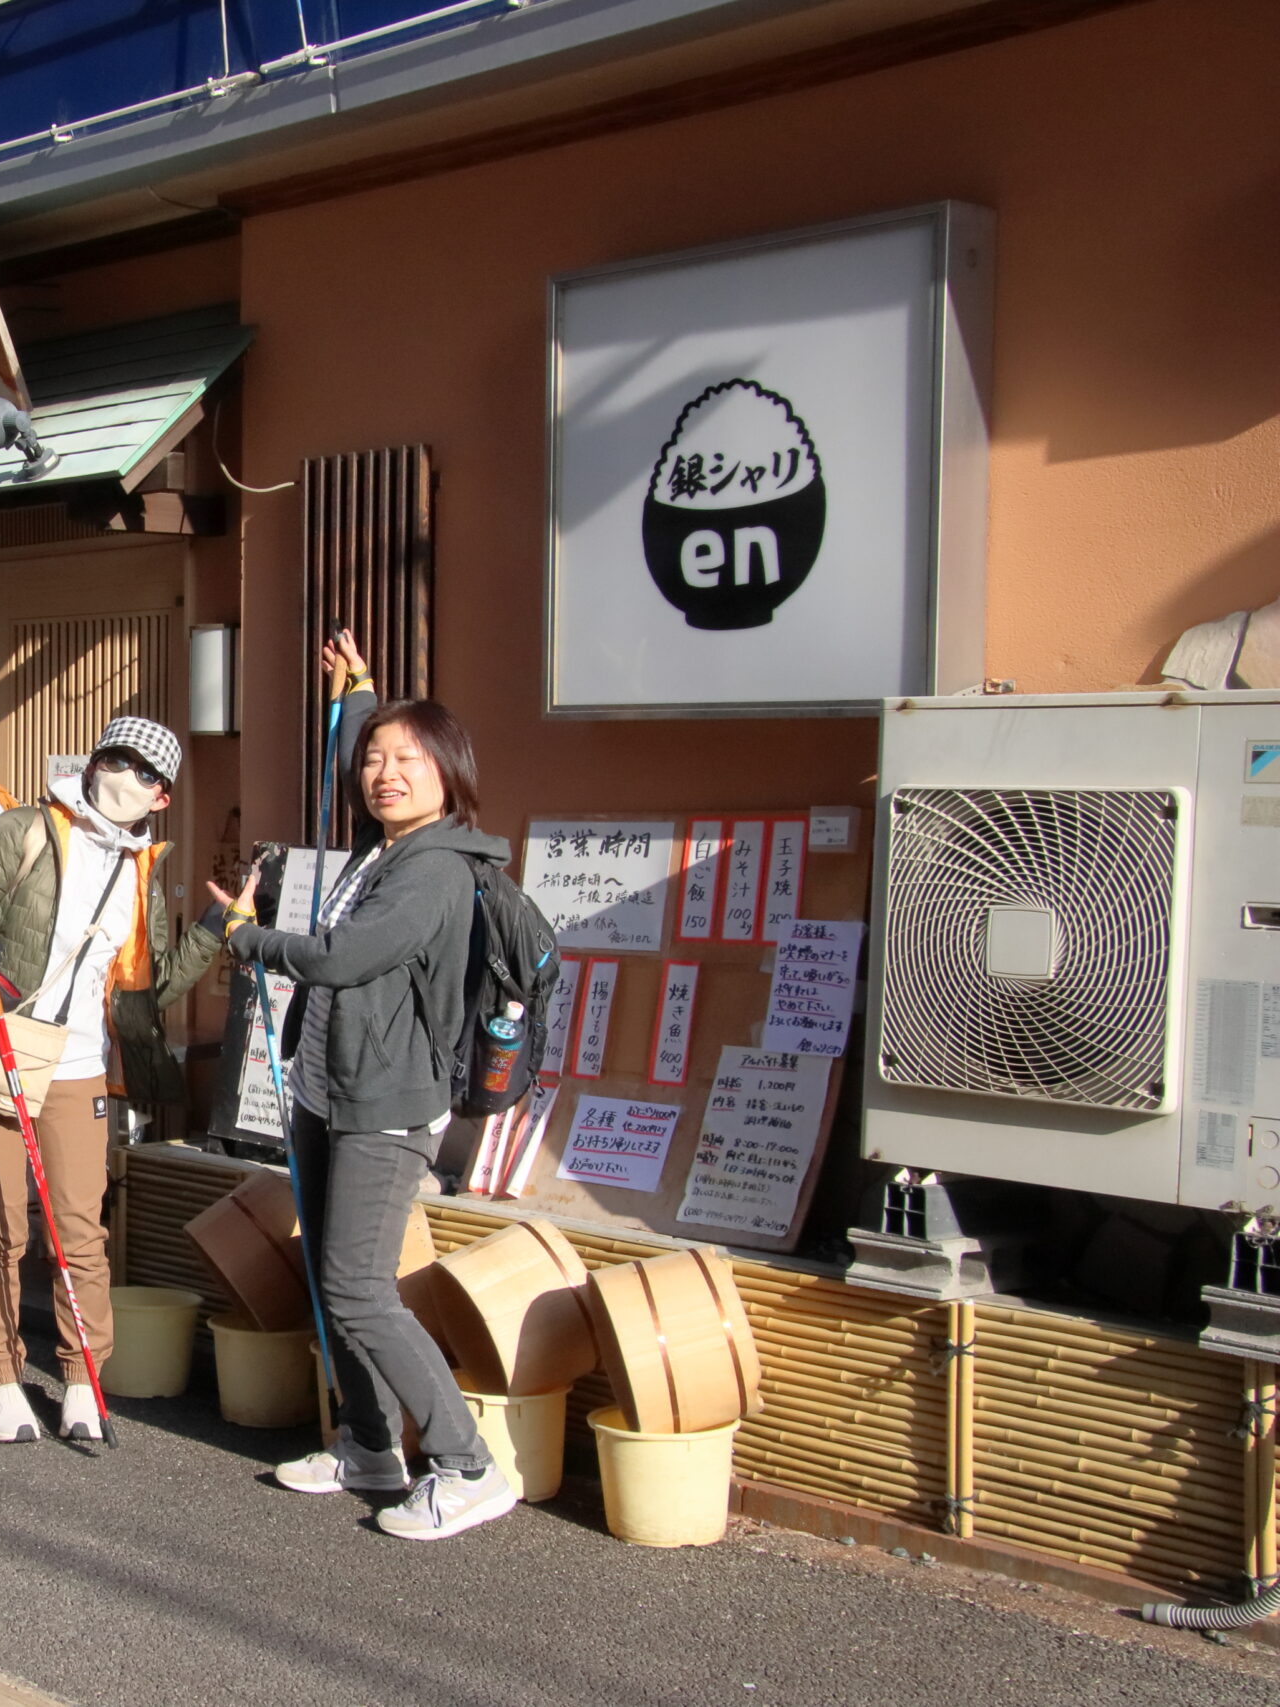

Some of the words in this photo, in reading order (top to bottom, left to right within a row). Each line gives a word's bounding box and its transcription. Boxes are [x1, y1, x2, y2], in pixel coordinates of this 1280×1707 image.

[668, 448, 800, 501] 銀シャリ
[680, 526, 780, 588] en
[545, 829, 651, 858] 営業時間
[688, 832, 711, 901] 白ご飯
[732, 840, 751, 898] みそ汁
[773, 837, 794, 896] 玉子焼
[685, 915, 706, 928] 150
[728, 908, 752, 920] 100
[552, 978, 573, 1031] おでん
[587, 980, 609, 1047] 揚げもの
[665, 983, 690, 1044] 焼き魚
[581, 1107, 617, 1129] 各種
